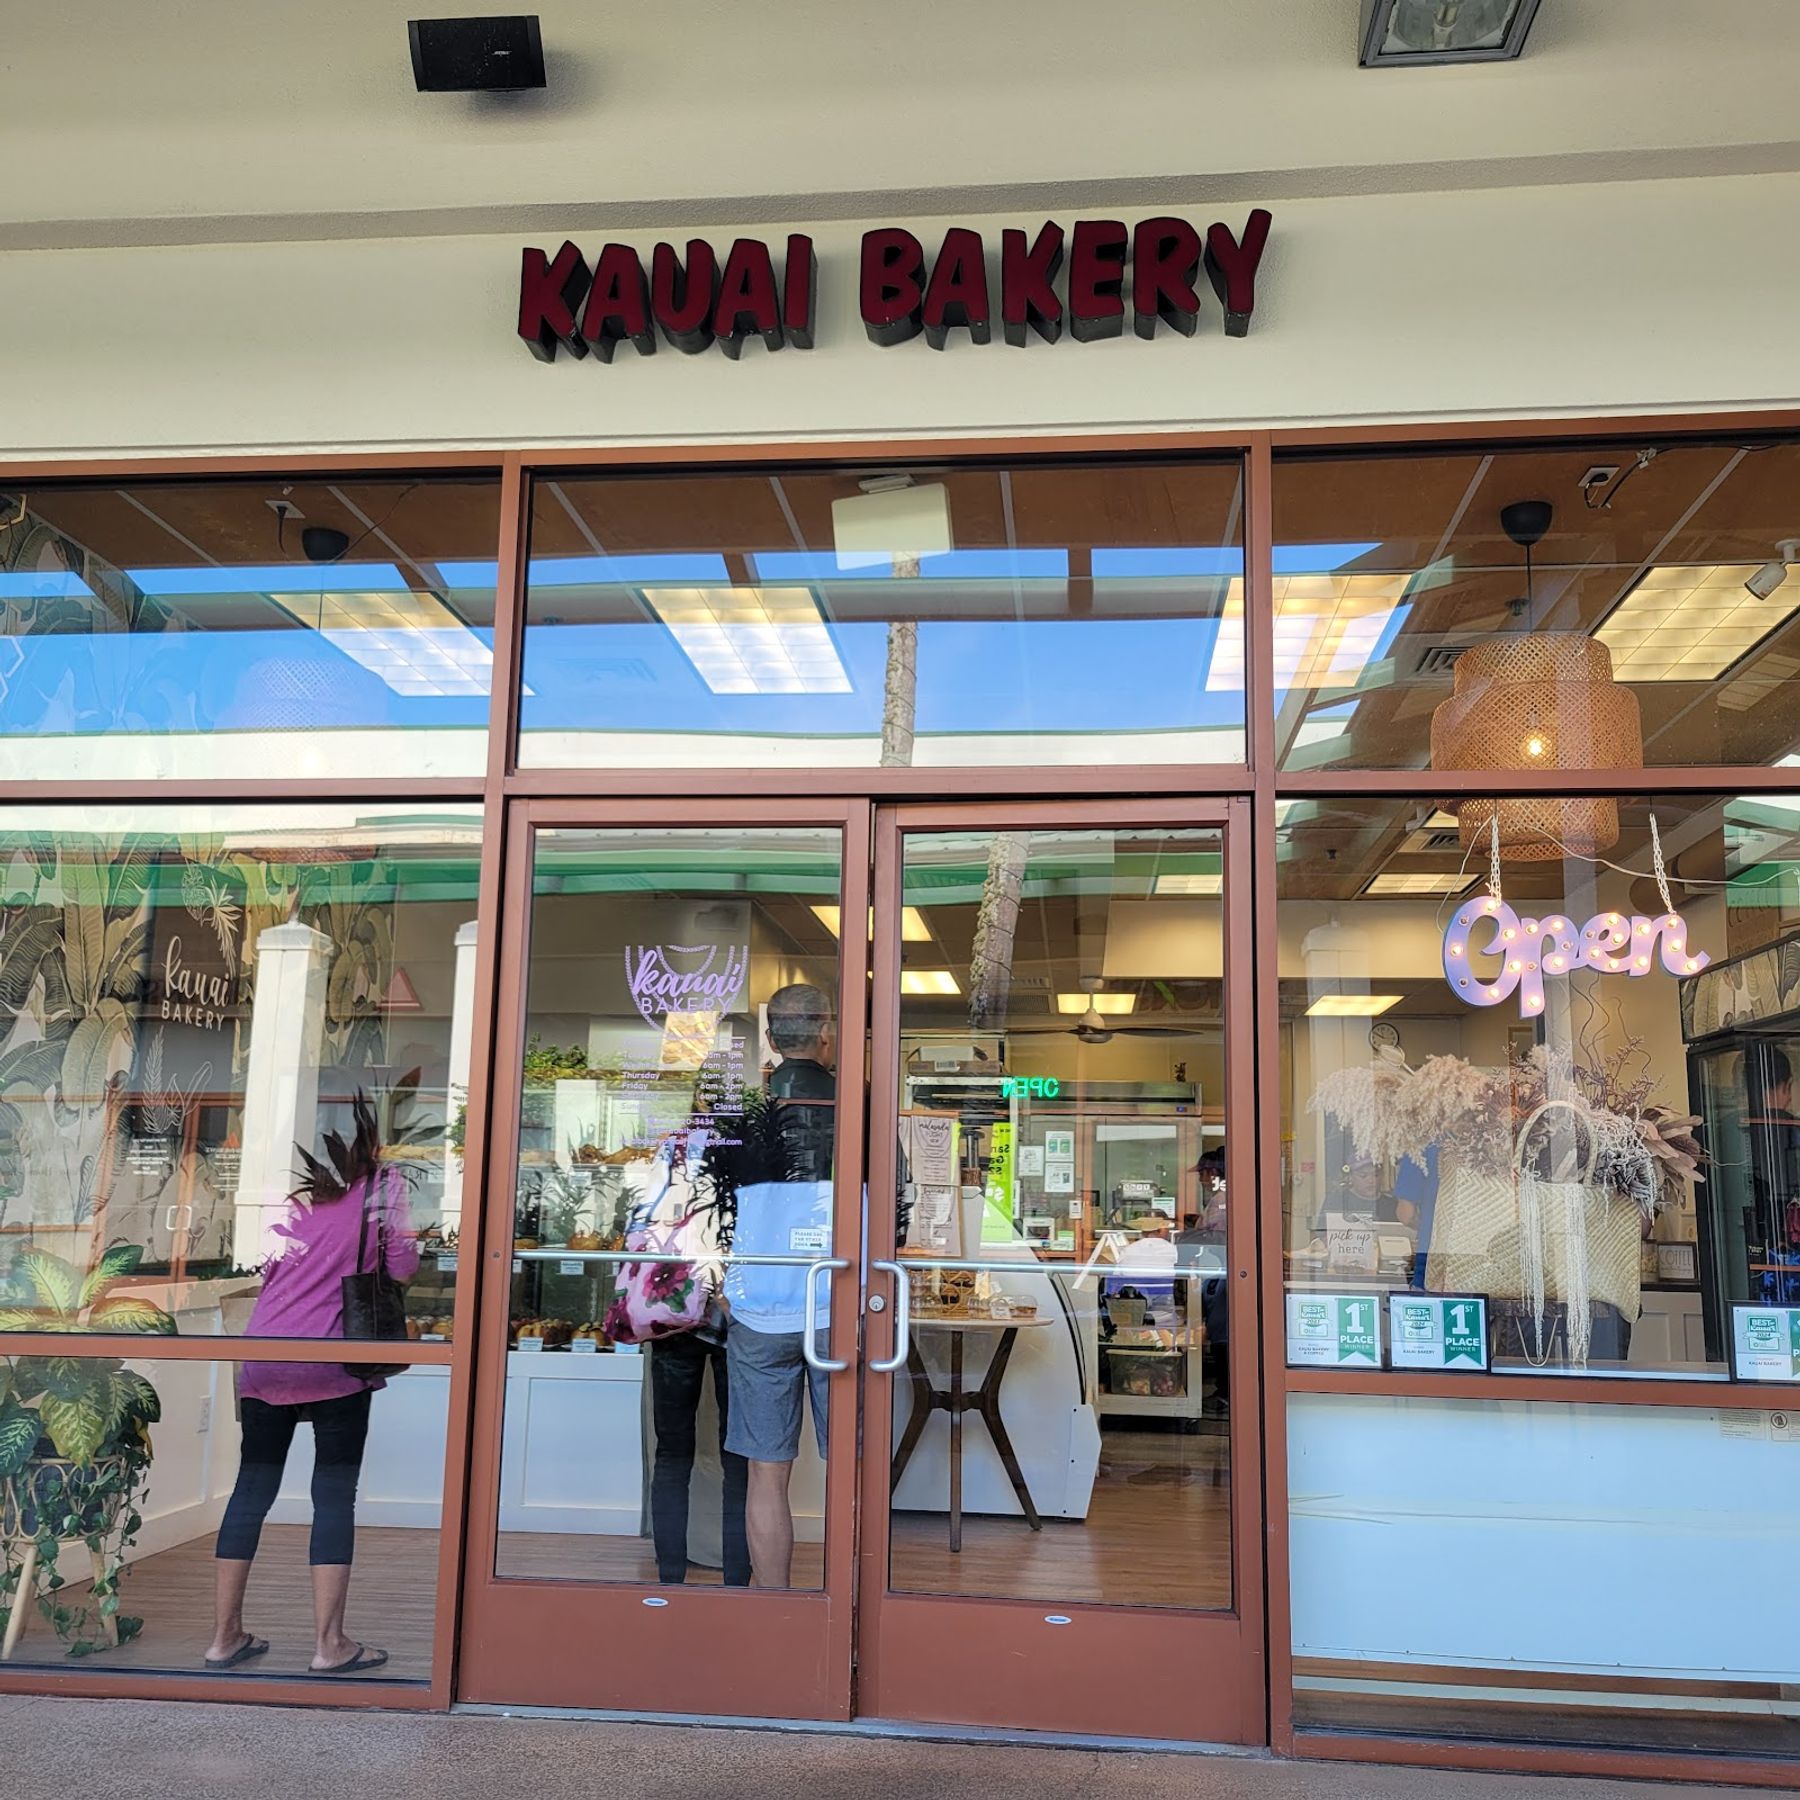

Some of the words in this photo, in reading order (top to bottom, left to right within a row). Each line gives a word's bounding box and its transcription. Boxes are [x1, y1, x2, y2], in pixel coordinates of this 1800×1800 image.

[518, 236, 818, 363] KAUAI
[859, 209, 1273, 350] BAKERY
[1441, 895, 1712, 1019] Open
[160, 935, 230, 1008] kauai
[631, 949, 742, 998] kauai
[640, 997, 731, 1014] BAKERY
[161, 1000, 226, 1032] BAKERY
[622, 1071, 661, 1081] Thursday
[622, 1082, 649, 1091] Friday
[700, 1082, 718, 1090] 6am
[713, 1103, 743, 1111] Closed
[1328, 1228, 1353, 1246] pick
[1356, 1233, 1371, 1247] up
[1338, 1243, 1365, 1254] here
[1340, 1335, 1375, 1344] PLACE
[1445, 1337, 1481, 1347] PLACE
